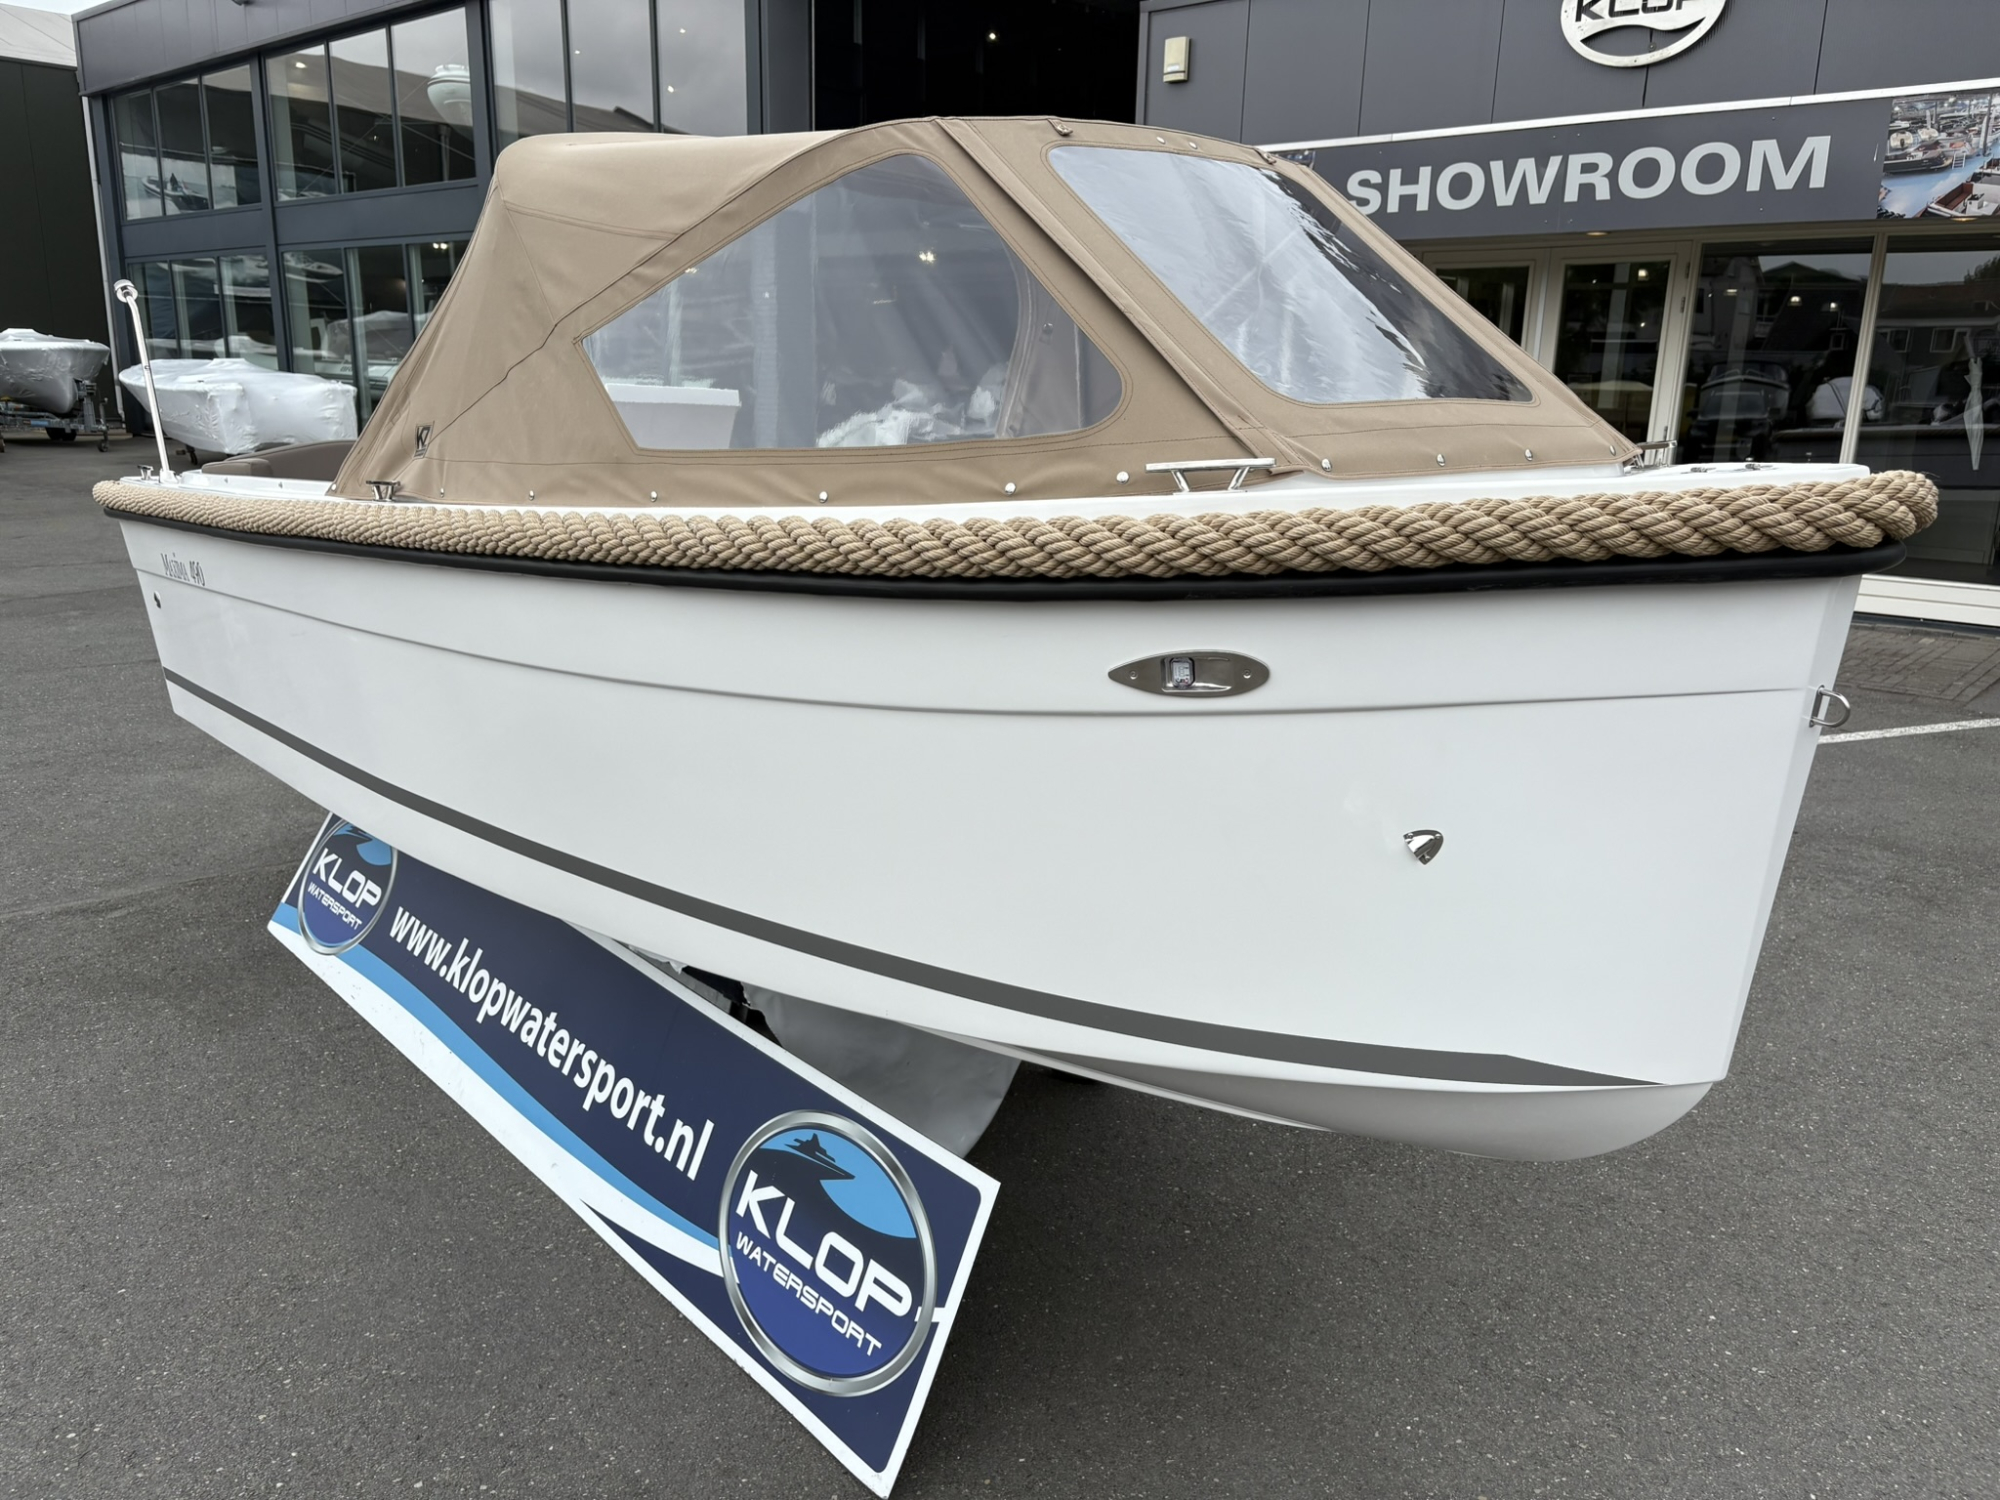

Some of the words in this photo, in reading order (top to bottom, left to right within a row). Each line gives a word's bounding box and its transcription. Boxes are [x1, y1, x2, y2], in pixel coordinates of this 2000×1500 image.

[1346, 135, 1831, 215] SHOWROOM
[307, 881, 363, 930] WATERSPORT
[312, 848, 382, 908] KLOP
[389, 906, 715, 1181] www.klopwatersport.nl
[735, 1169, 912, 1317] KLOP
[736, 1231, 882, 1356] WATERSPORT
